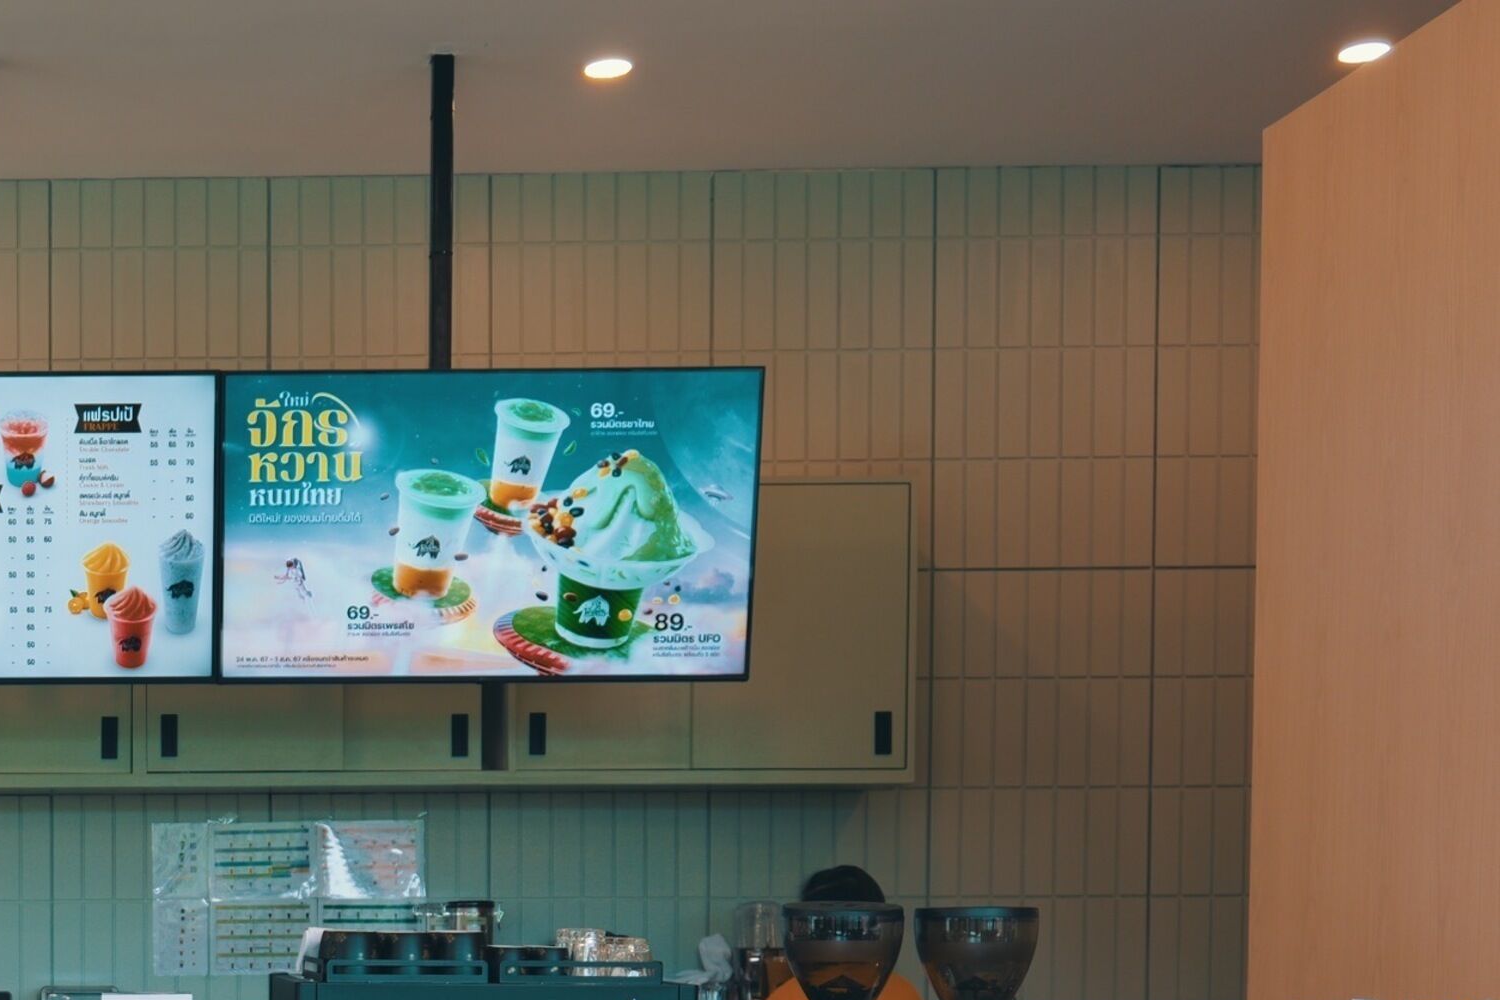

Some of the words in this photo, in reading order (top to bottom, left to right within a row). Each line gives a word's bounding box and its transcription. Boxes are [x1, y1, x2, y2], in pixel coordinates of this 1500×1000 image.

[591, 403, 625, 418] 69.-
[247, 398, 348, 447] จักร
[248, 451, 363, 482] หวาน
[249, 481, 342, 506] หนมไทย
[347, 606, 379, 620] 69.-
[698, 634, 721, 643] UFO
